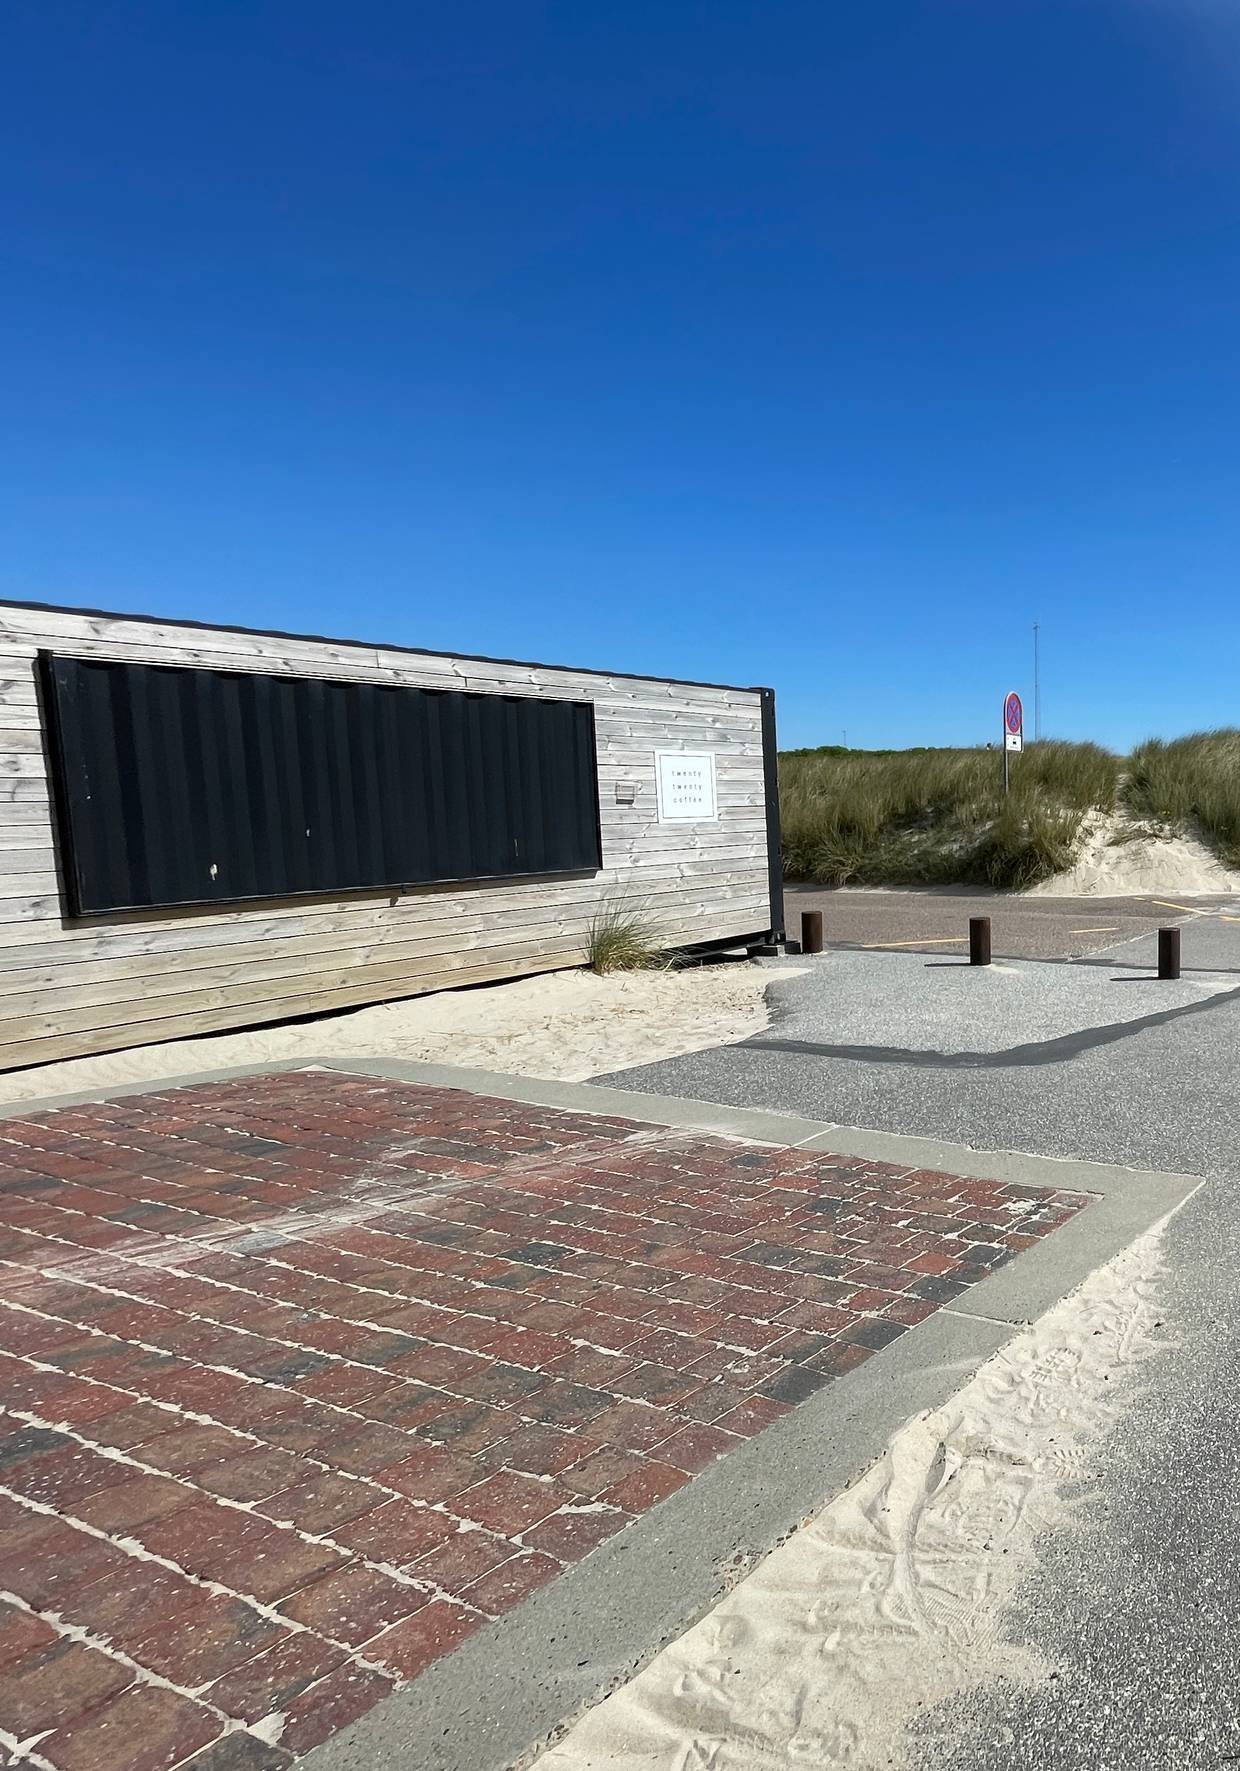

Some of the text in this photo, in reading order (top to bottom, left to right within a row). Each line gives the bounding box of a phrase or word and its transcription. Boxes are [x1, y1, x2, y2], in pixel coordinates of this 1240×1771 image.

[671, 770, 702, 778] twenty
[672, 783, 702, 791] twenty
[673, 796, 702, 804] coffee
